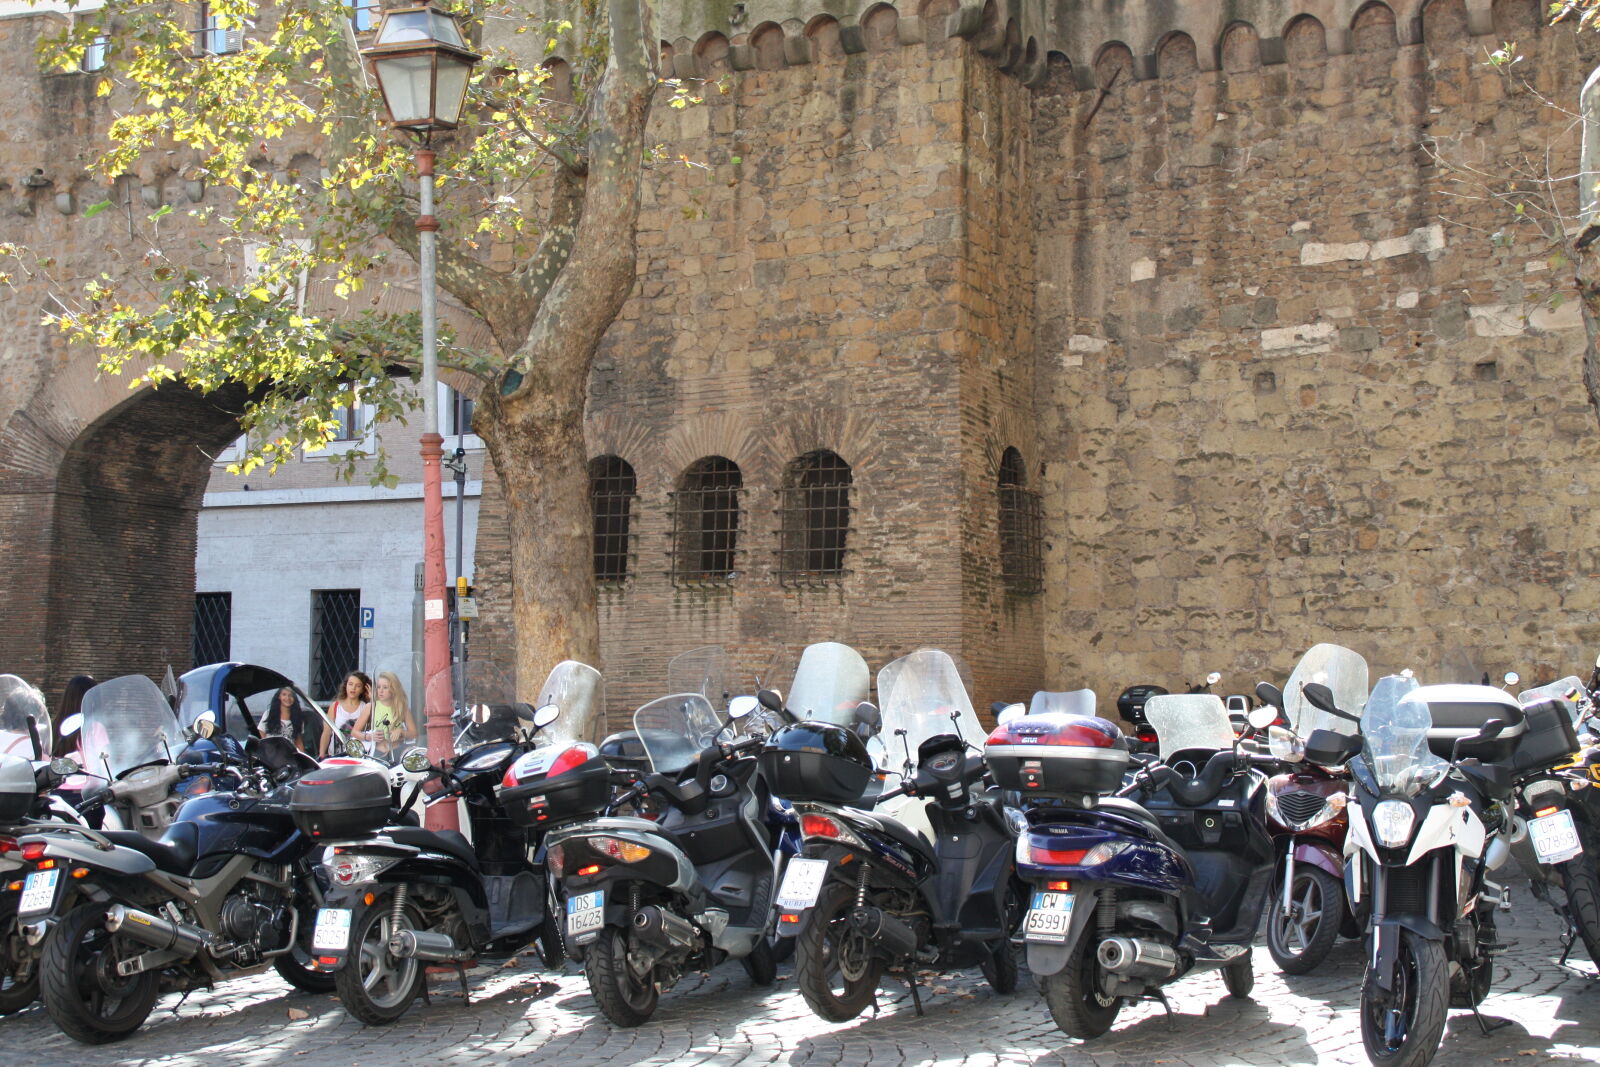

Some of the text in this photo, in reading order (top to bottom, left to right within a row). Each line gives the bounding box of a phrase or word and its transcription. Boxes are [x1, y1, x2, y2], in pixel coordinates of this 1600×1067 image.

[363, 609, 372, 626] P
[33, 873, 45, 889] BT
[576, 895, 589, 911] DS
[1042, 893, 1059, 909] CW
[325, 910, 338, 925] DB
[570, 910, 602, 931] 16423
[1030, 913, 1067, 931] 55991
